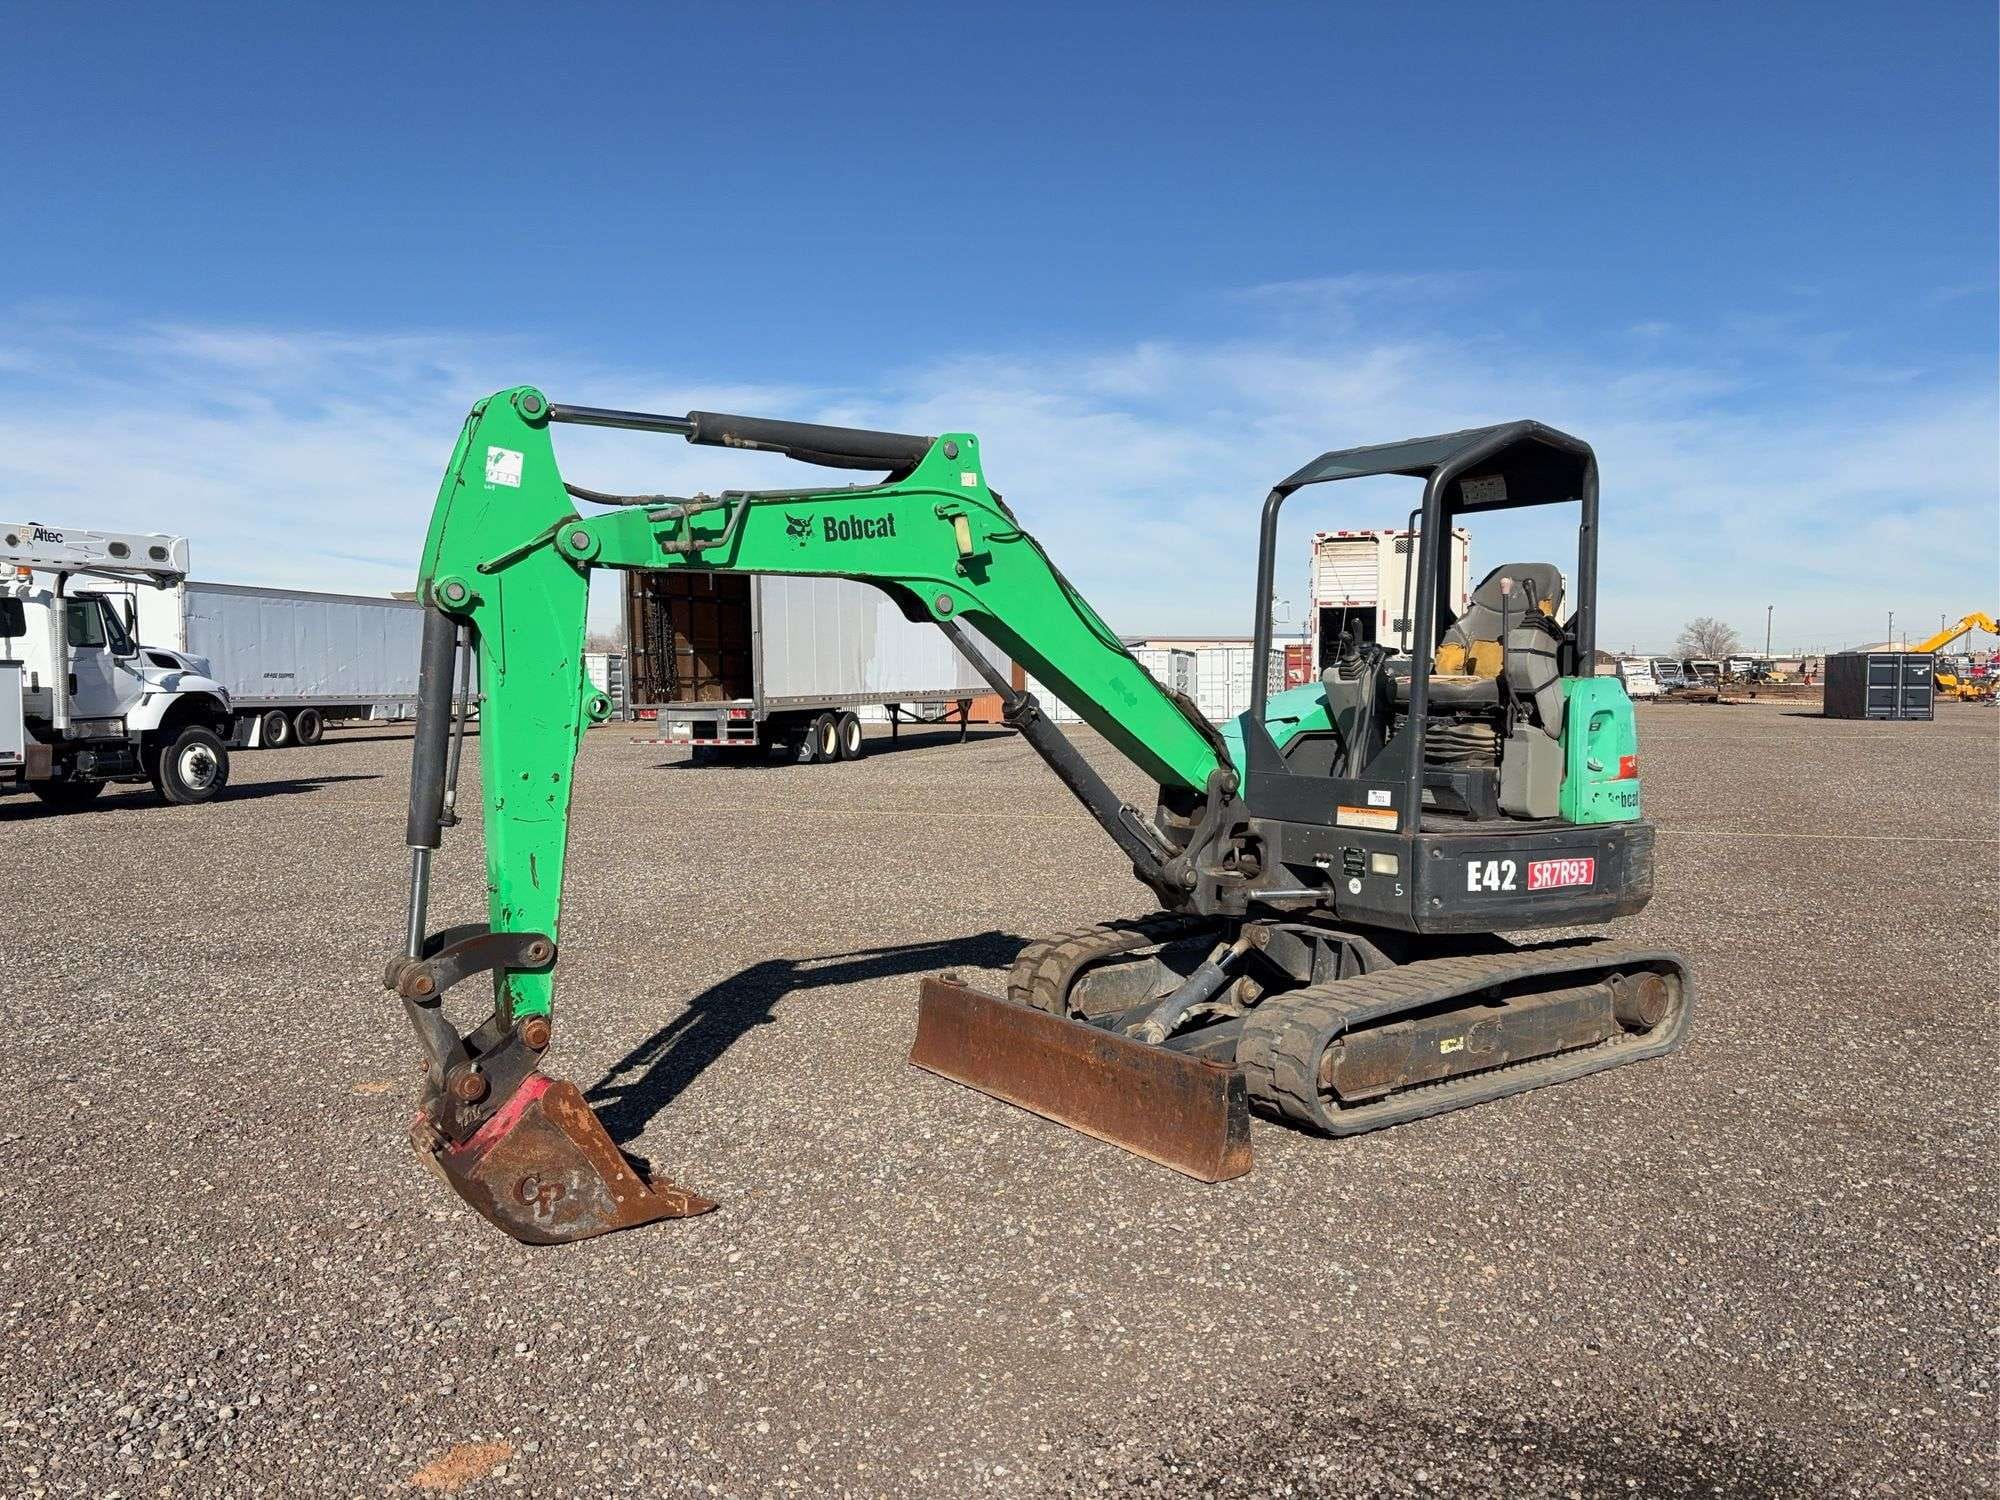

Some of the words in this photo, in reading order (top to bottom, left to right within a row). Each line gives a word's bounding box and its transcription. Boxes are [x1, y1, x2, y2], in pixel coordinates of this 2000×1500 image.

[33, 528, 63, 543] Altec
[823, 513, 896, 542] Bobcat
[1467, 860, 1517, 891] E42
[1533, 861, 1588, 888] SR7R93
[1394, 883, 1404, 897] 5
